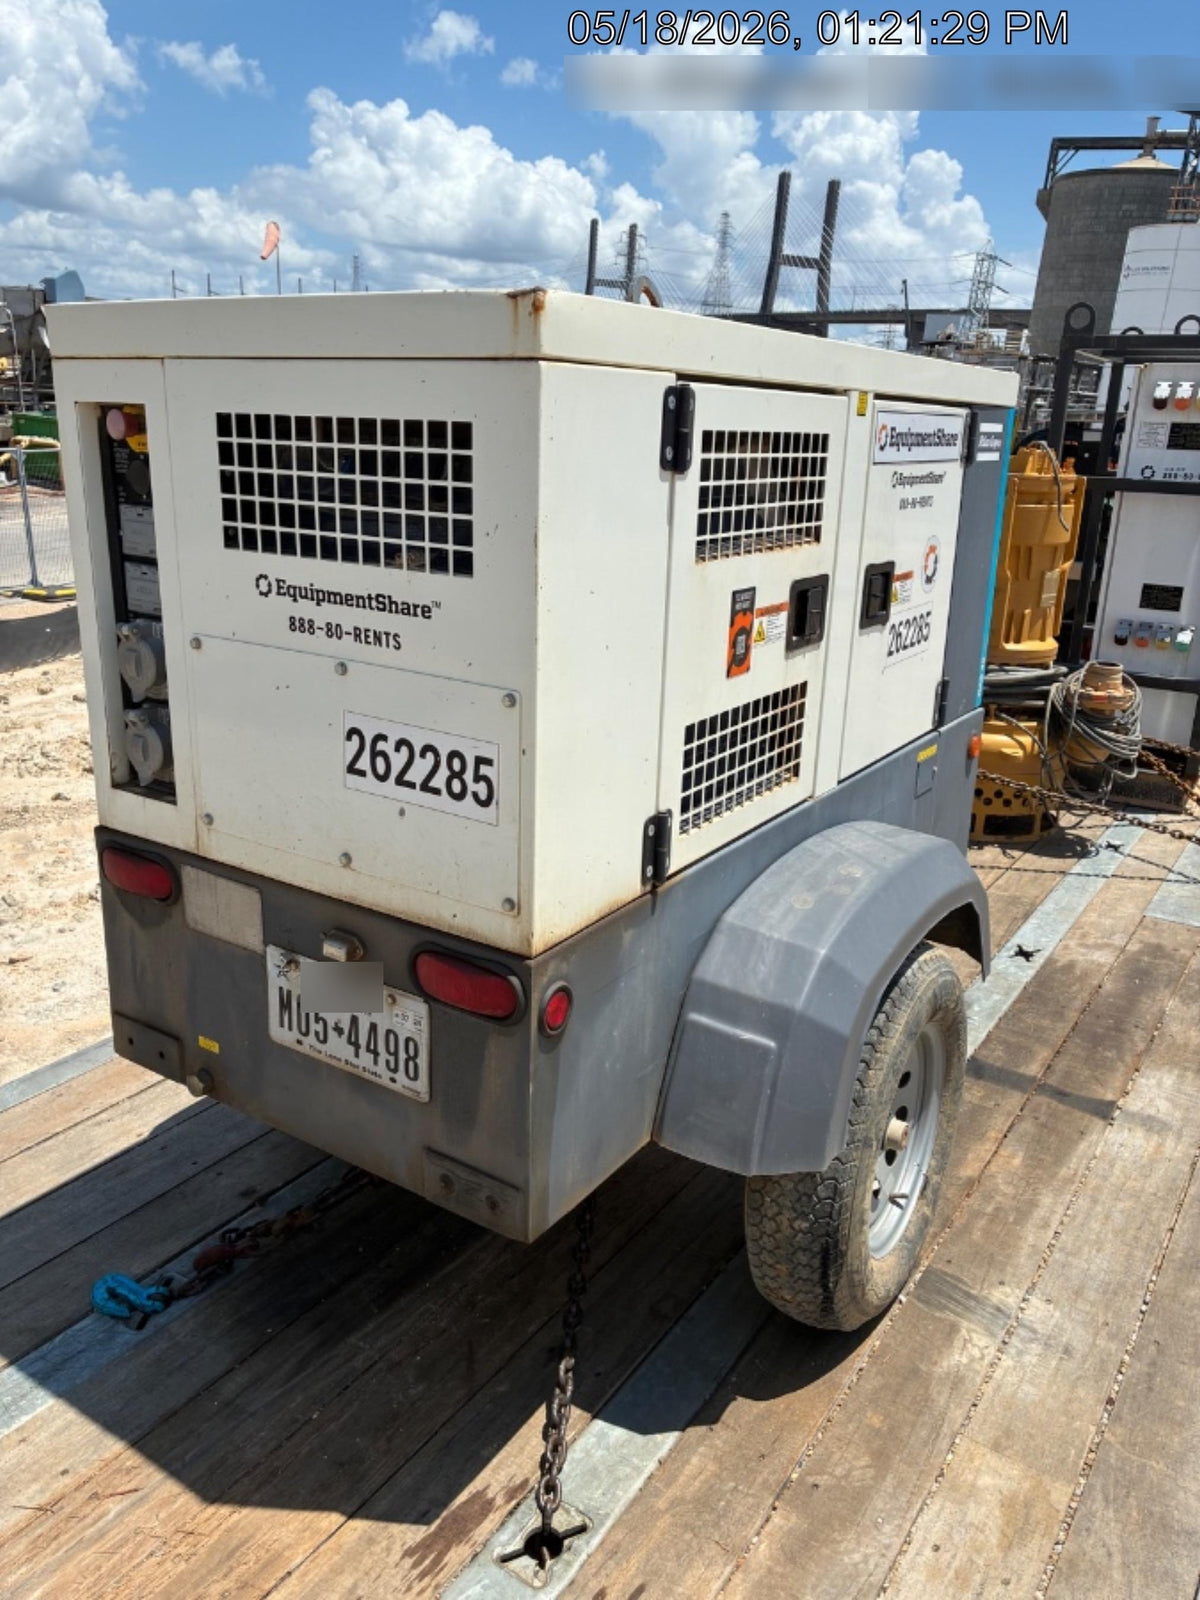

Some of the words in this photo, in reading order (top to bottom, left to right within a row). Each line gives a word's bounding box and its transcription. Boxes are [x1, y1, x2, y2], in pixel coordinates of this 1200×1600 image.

[888, 426, 959, 453] EquipmentShare
[288, 616, 402, 650] 888-80-RENTS
[887, 611, 931, 657] 262285
[345, 726, 495, 808] 262285
